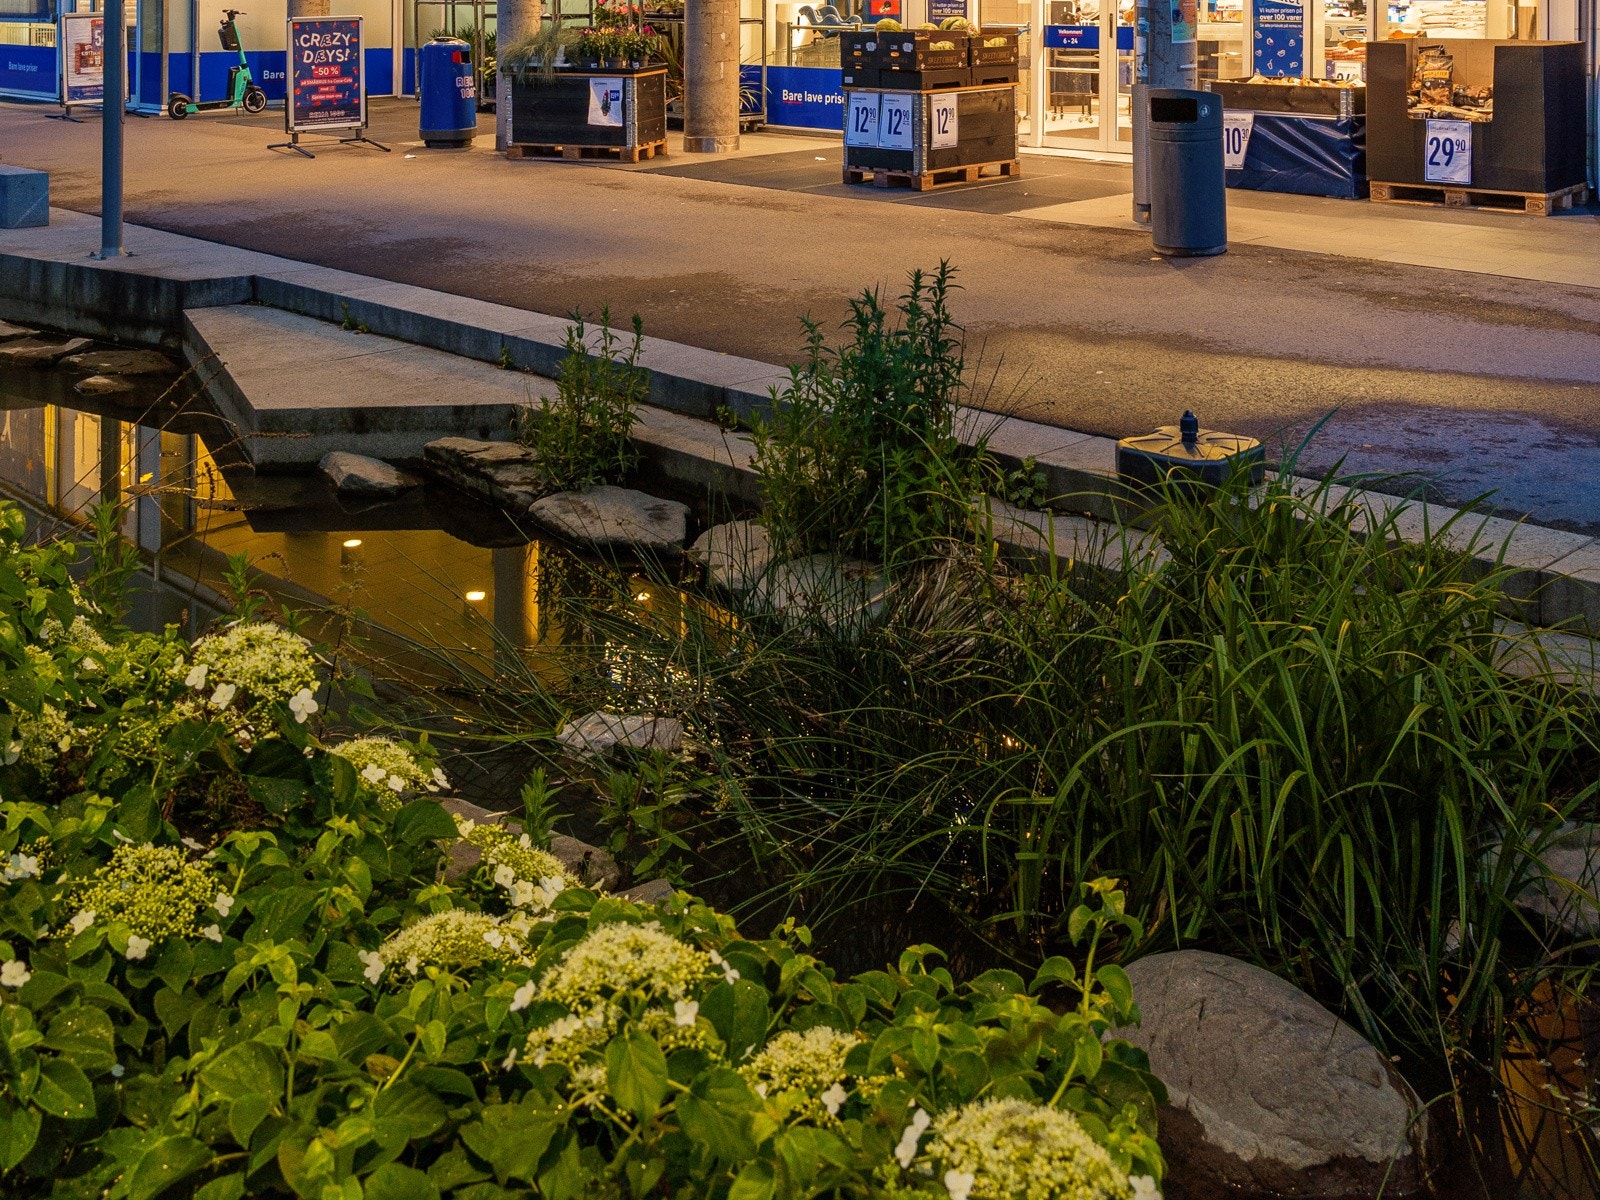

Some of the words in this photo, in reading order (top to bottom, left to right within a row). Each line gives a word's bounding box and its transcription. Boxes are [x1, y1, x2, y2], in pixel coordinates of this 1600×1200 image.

[300, 32, 350, 47] CRÆZY
[303, 48, 350, 63] DÆYS!
[8, 61, 17, 71] Bare
[26, 63, 38, 73] priser
[263, 70, 285, 80] Bare
[314, 67, 329, 76] -50
[330, 66, 339, 75] %
[783, 89, 802, 101] Bare
[804, 91, 822, 102] lave
[825, 93, 845, 105] pris
[855, 106, 869, 133] 12
[888, 108, 902, 135] 12
[936, 107, 948, 134] 12
[1225, 127, 1241, 154] 10
[1429, 136, 1454, 167] 29
[1455, 139, 1466, 151] 90
